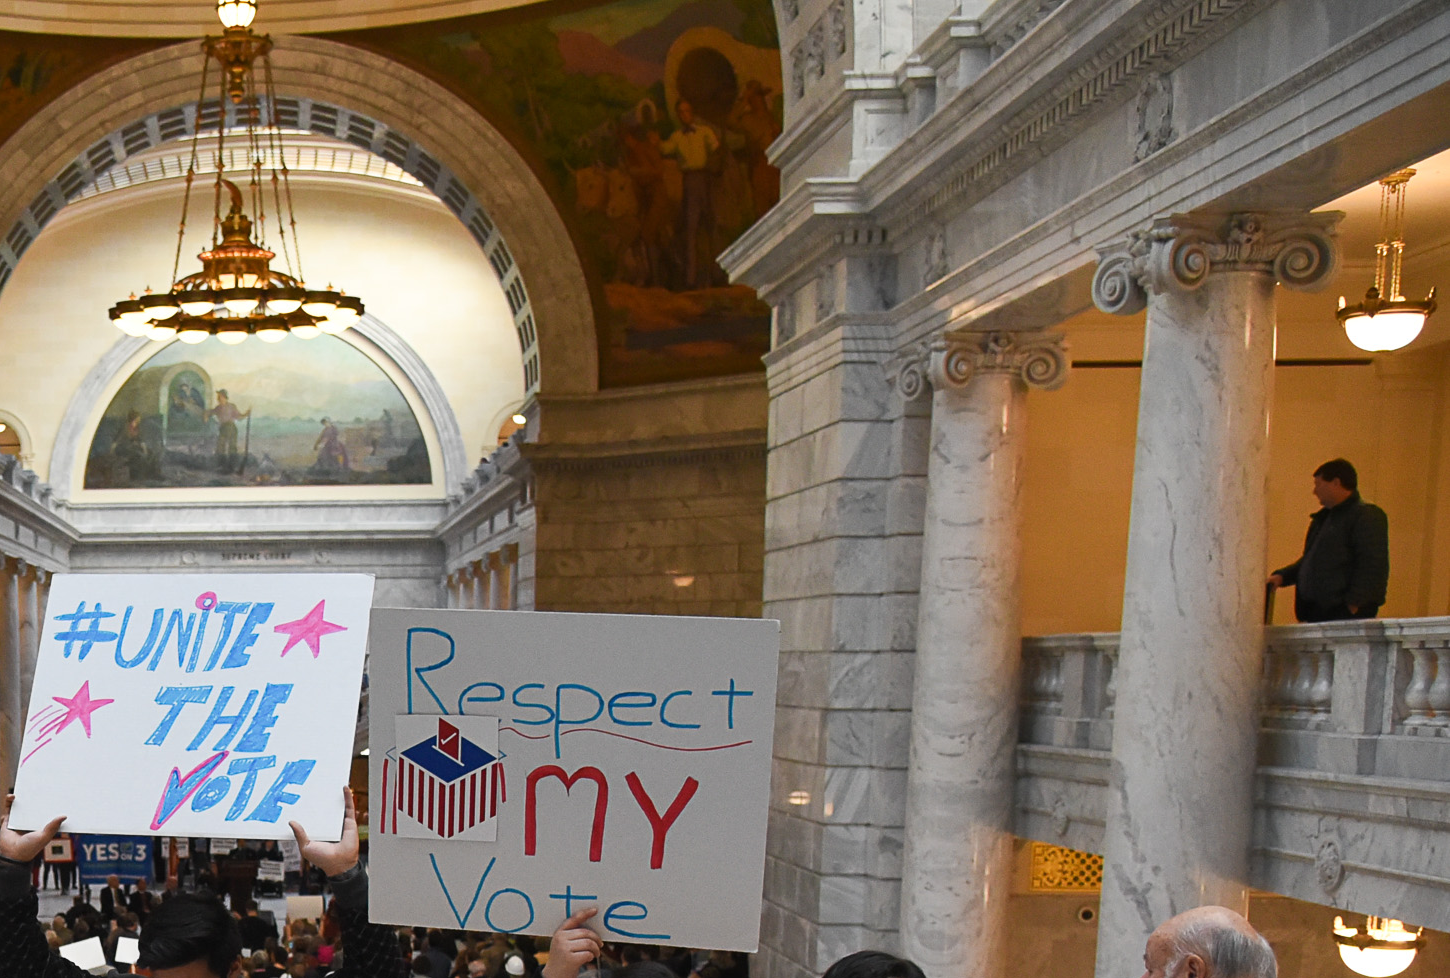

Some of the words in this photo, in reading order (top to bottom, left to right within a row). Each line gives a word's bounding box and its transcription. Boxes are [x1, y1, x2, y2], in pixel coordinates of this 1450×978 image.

[144, 683, 294, 752] THE
[407, 627, 754, 759] Respect
[82, 843, 119, 861] YES
[134, 844, 147, 862] 3
[429, 853, 671, 940] Vote
